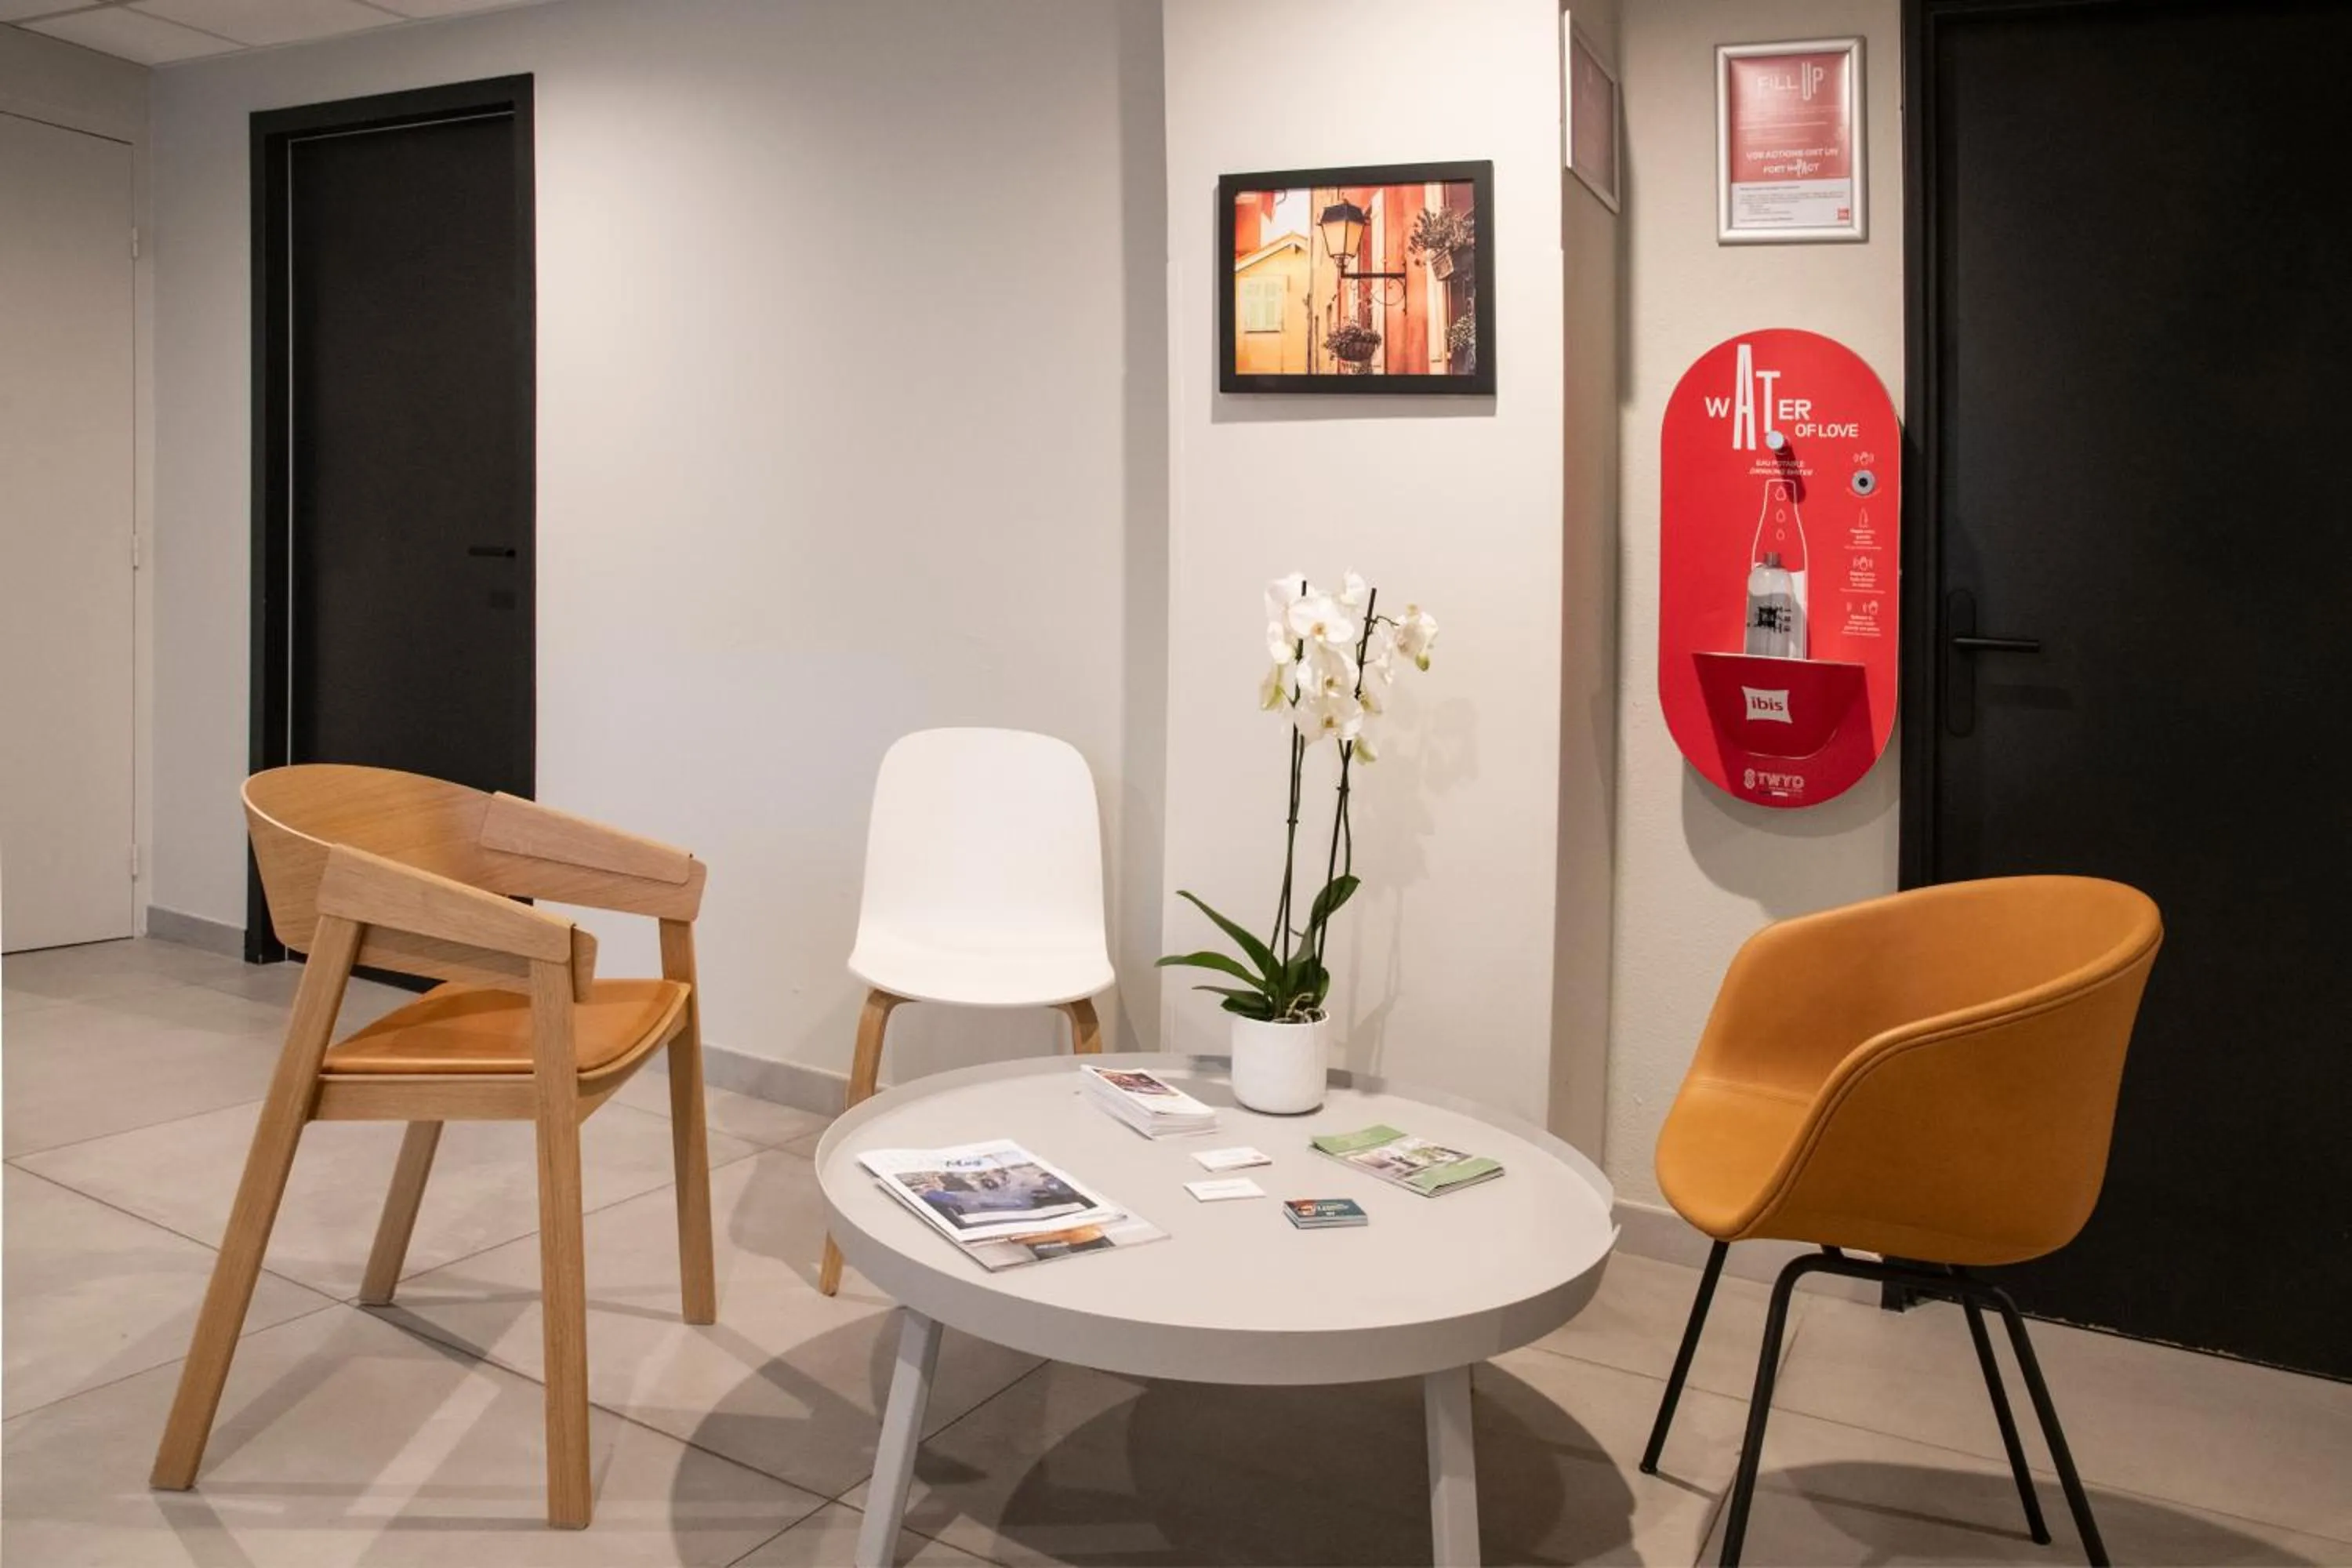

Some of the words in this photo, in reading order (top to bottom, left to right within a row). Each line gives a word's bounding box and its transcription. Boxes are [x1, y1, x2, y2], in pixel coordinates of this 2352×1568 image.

[1758, 74, 1799, 91] FILL
[1802, 62, 1824, 100] UP
[1704, 343, 1812, 450] WATER
[1795, 423, 1816, 437] OF
[1818, 423, 1859, 437] LOVE
[1751, 696, 1784, 711] ibis
